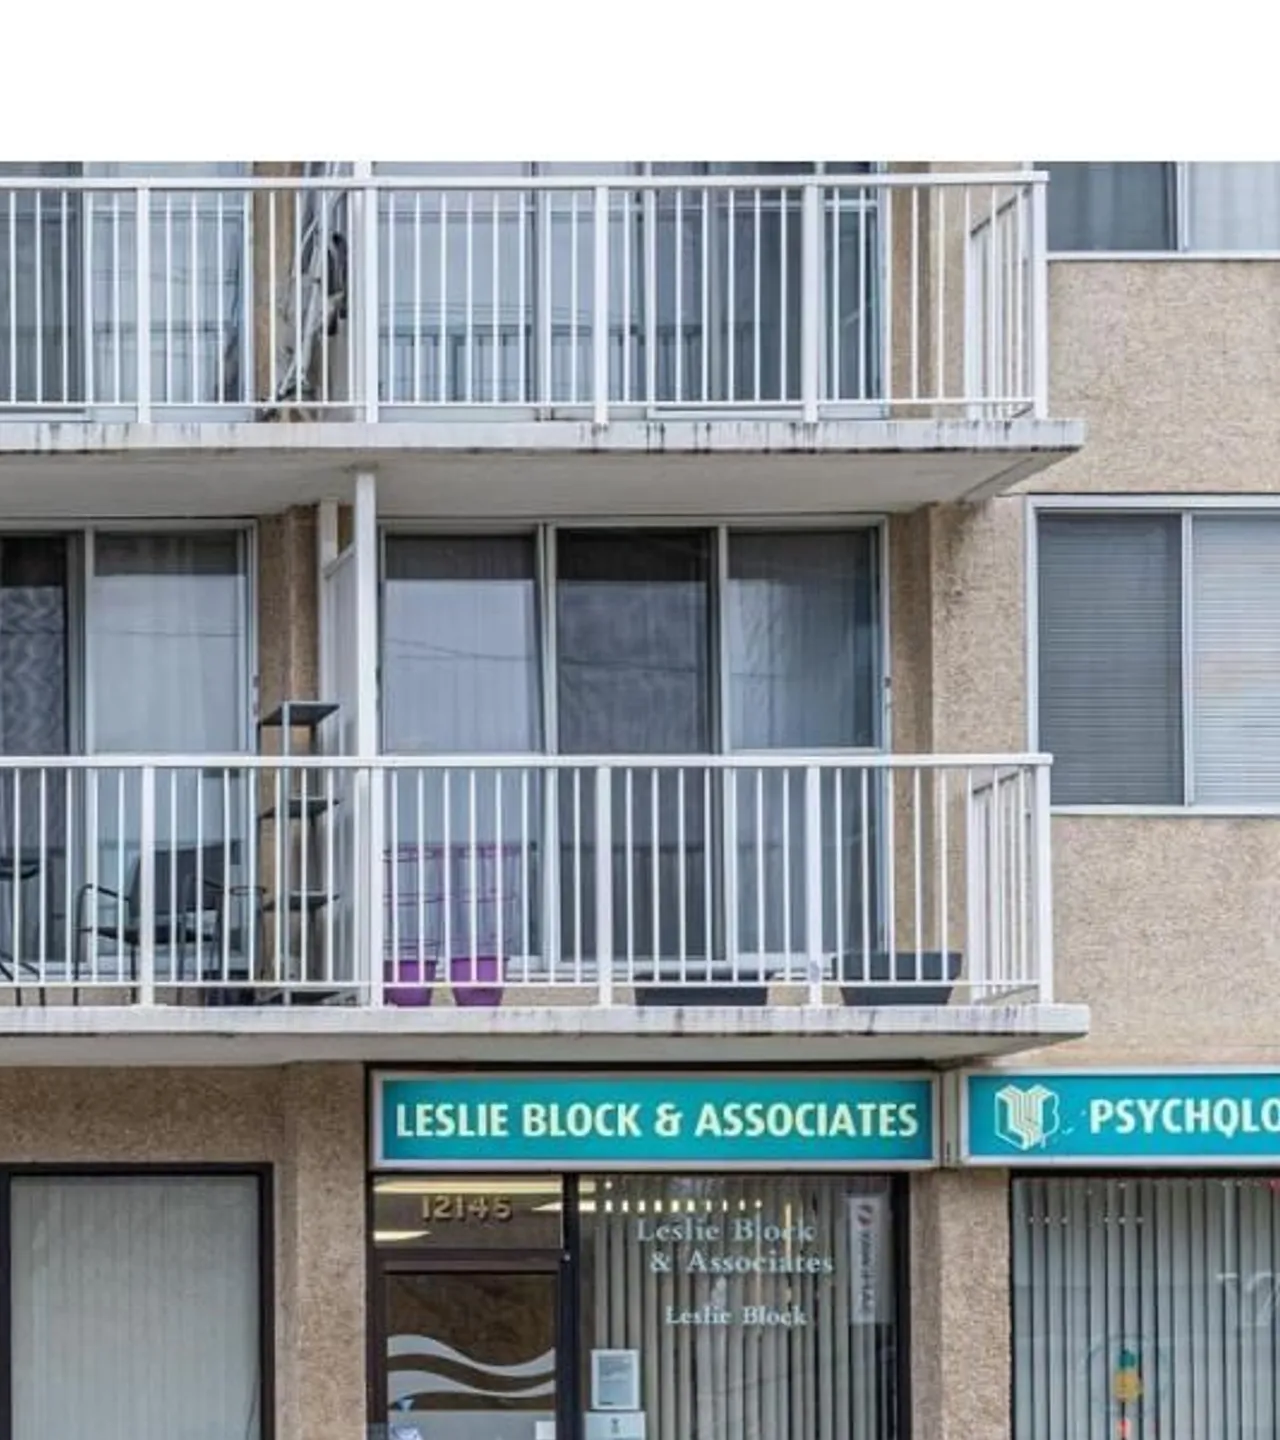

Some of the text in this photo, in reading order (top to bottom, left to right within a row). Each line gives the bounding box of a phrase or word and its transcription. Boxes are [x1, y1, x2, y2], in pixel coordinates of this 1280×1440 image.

[396, 1102, 919, 1138] LESLIE BLOCK & ASSOCIATES
[421, 1195, 514, 1221] 12145
[637, 1217, 817, 1243] Leslie Block
[649, 1249, 834, 1275] & Associates
[665, 1304, 808, 1326] Leslie Block
